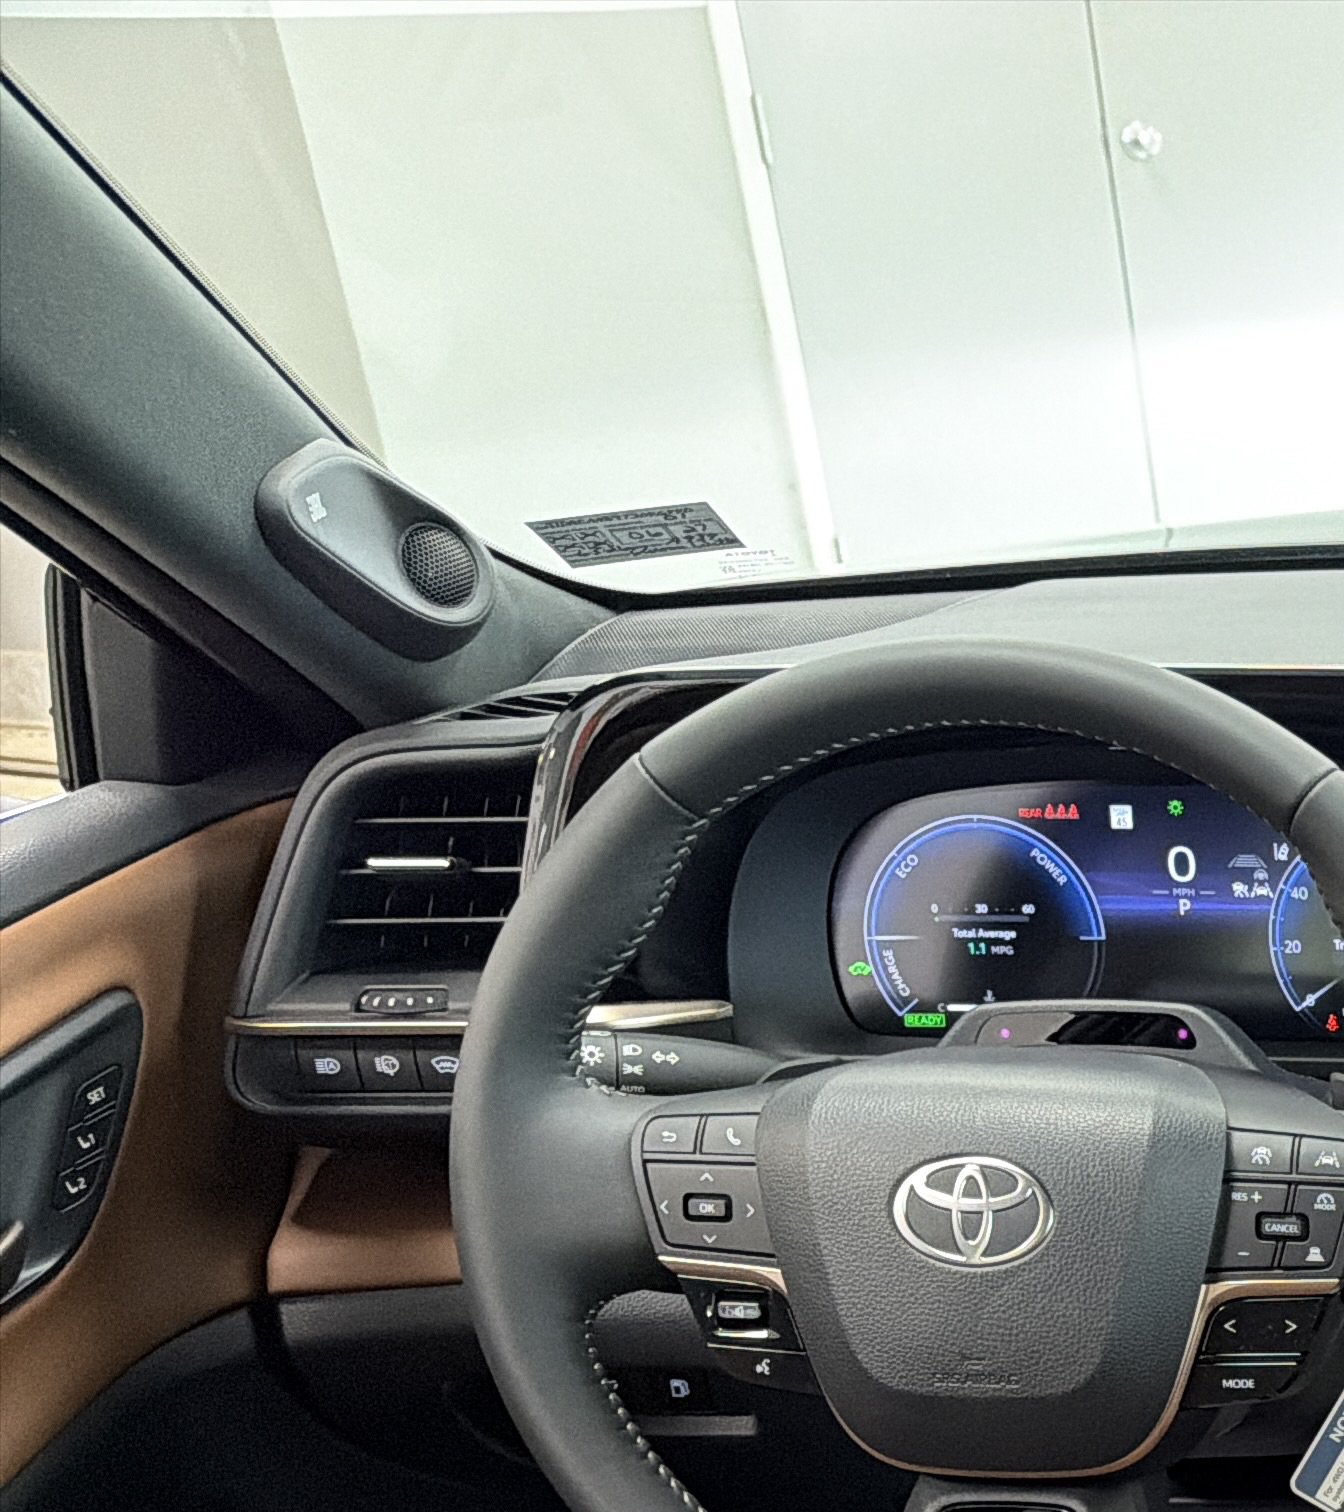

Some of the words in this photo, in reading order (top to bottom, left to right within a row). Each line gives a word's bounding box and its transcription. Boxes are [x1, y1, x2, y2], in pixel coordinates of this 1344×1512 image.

[895, 854, 919, 879] ECO
[1030, 848, 1068, 886] POWER
[1167, 845, 1196, 883] 0
[1172, 888, 1195, 896] MPH
[1290, 887, 1308, 900] 40
[975, 904, 988, 914] 30
[952, 928, 976, 938] Total
[978, 928, 1016, 940] Average
[968, 942, 987, 955] 1.1
[991, 946, 1014, 956] MPG
[1284, 940, 1302, 954] 20
[883, 949, 911, 997] CHARGE
[907, 1015, 943, 1025] READY
[621, 1085, 645, 1093] AUTO
[86, 1086, 106, 1105] SET
[1231, 1192, 1248, 1202] RES
[699, 1202, 715, 1213] OK
[1314, 1203, 1336, 1211] MODE
[1265, 1223, 1299, 1233] CANCEL
[1222, 1379, 1255, 1389] MODE
